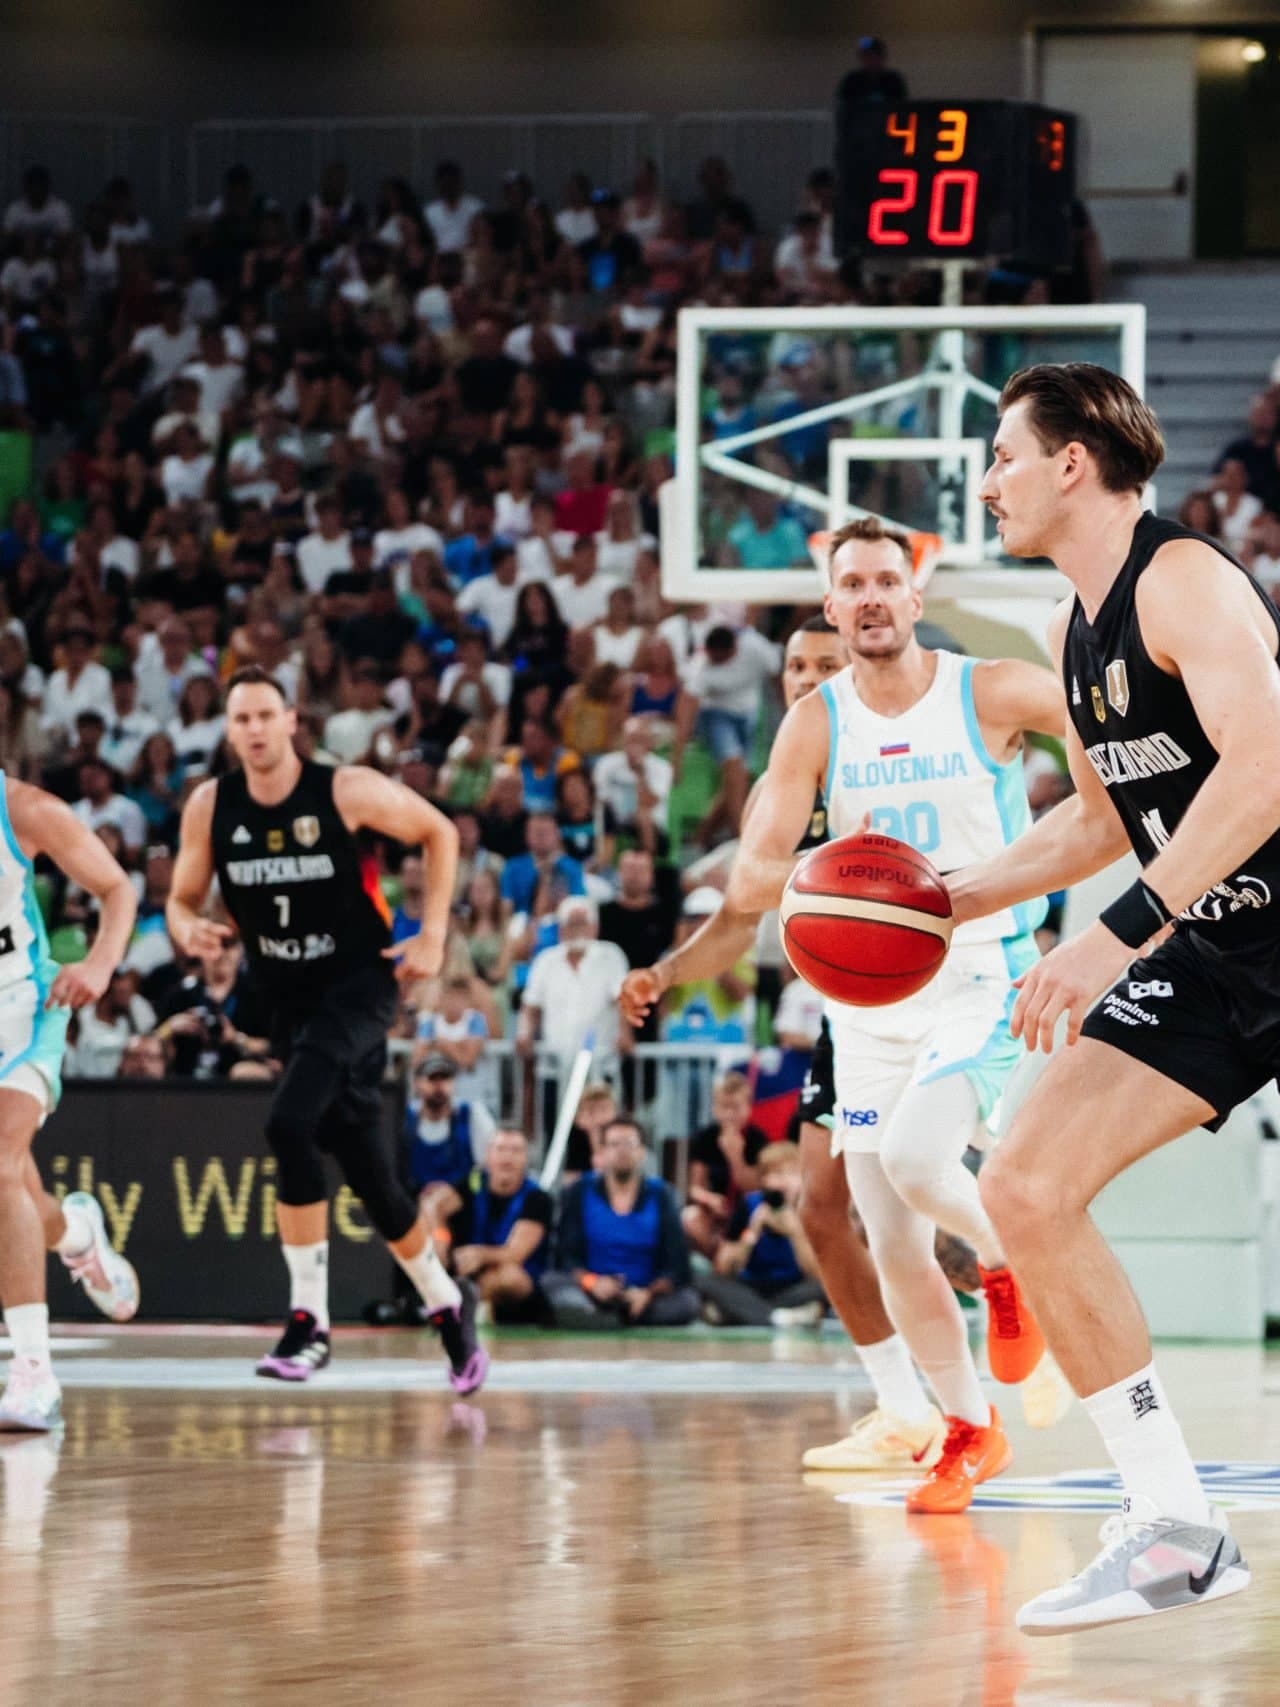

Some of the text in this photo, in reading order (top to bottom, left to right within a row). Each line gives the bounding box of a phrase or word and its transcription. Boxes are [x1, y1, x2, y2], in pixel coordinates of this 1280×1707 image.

[867, 168, 979, 246] 20
[841, 751, 969, 789] SLOVENIJA
[838, 864, 917, 889] molten
[273, 894, 290, 928] 7
[1103, 993, 1160, 1026] Domino's
[1103, 1005, 1142, 1026] Pizza
